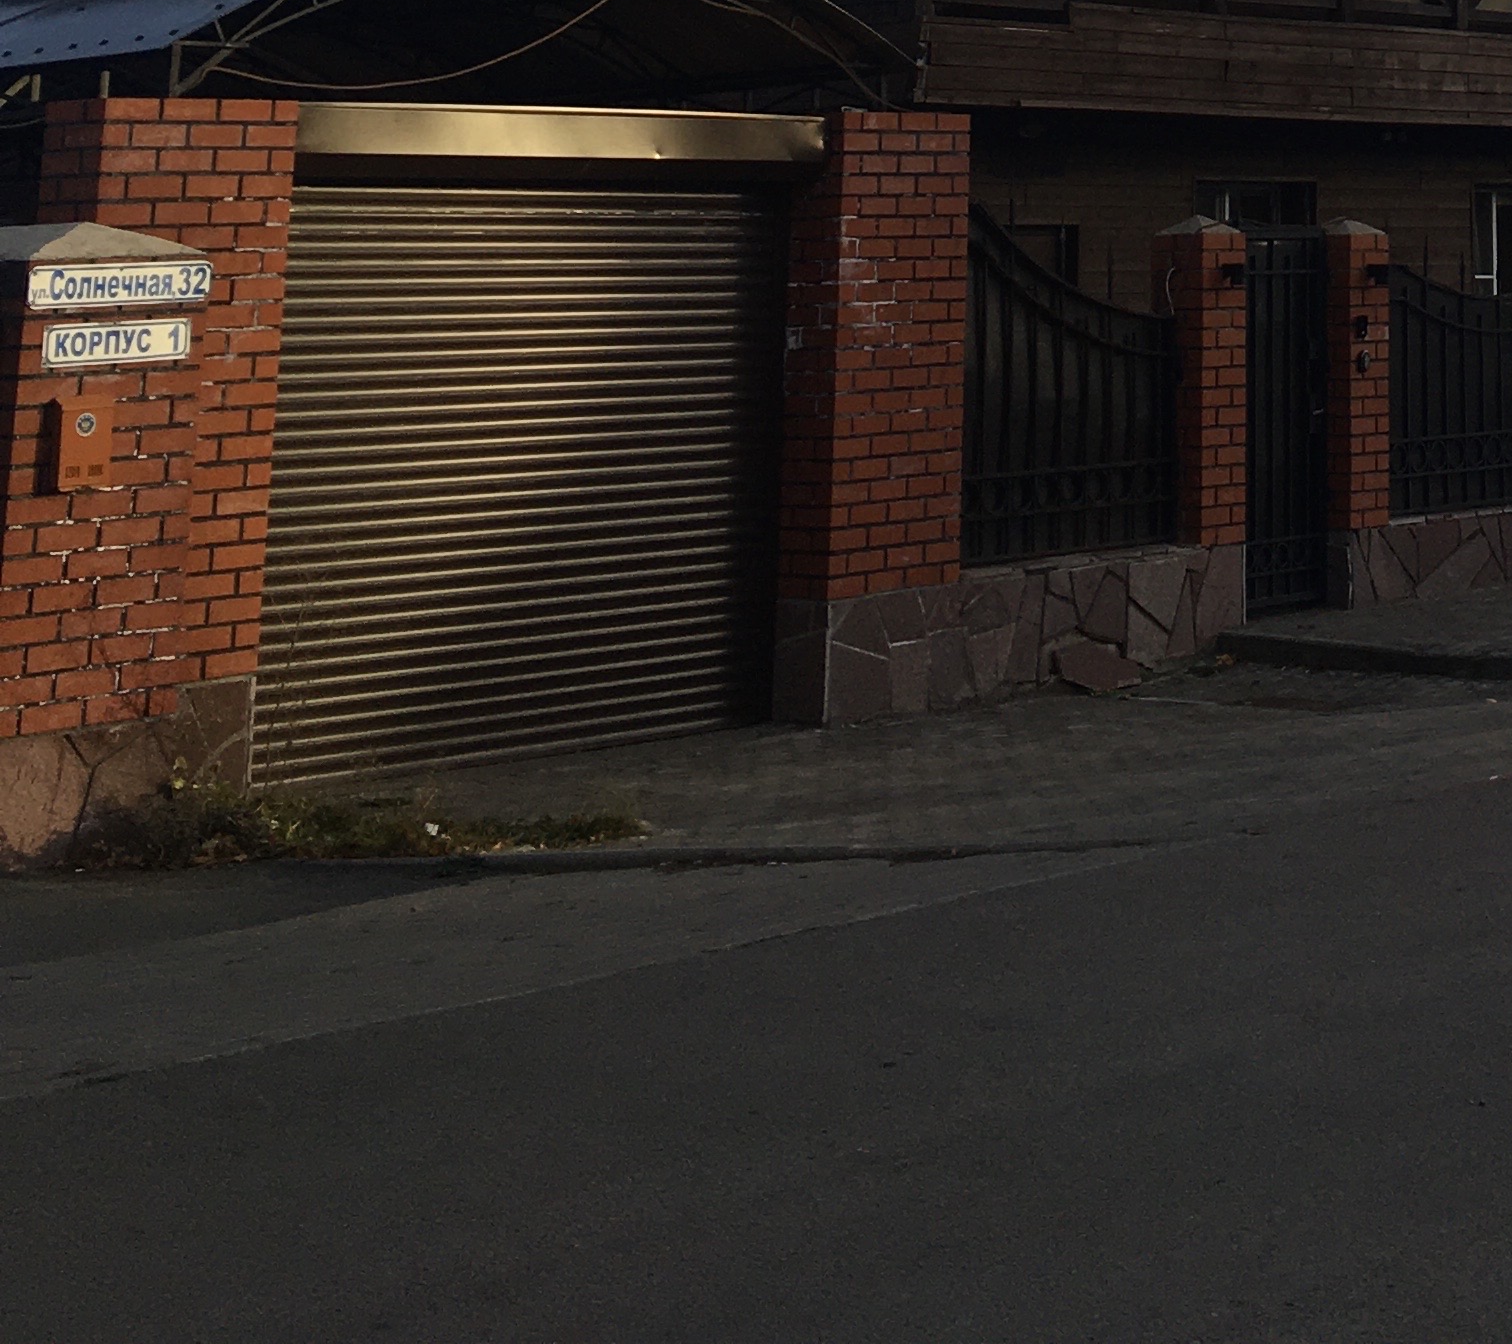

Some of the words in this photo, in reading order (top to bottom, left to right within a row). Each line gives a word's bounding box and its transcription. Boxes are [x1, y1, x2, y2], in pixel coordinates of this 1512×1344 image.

[177, 267, 208, 296] 32
[54, 328, 152, 358] КОРПУС
[167, 325, 180, 352] 1
